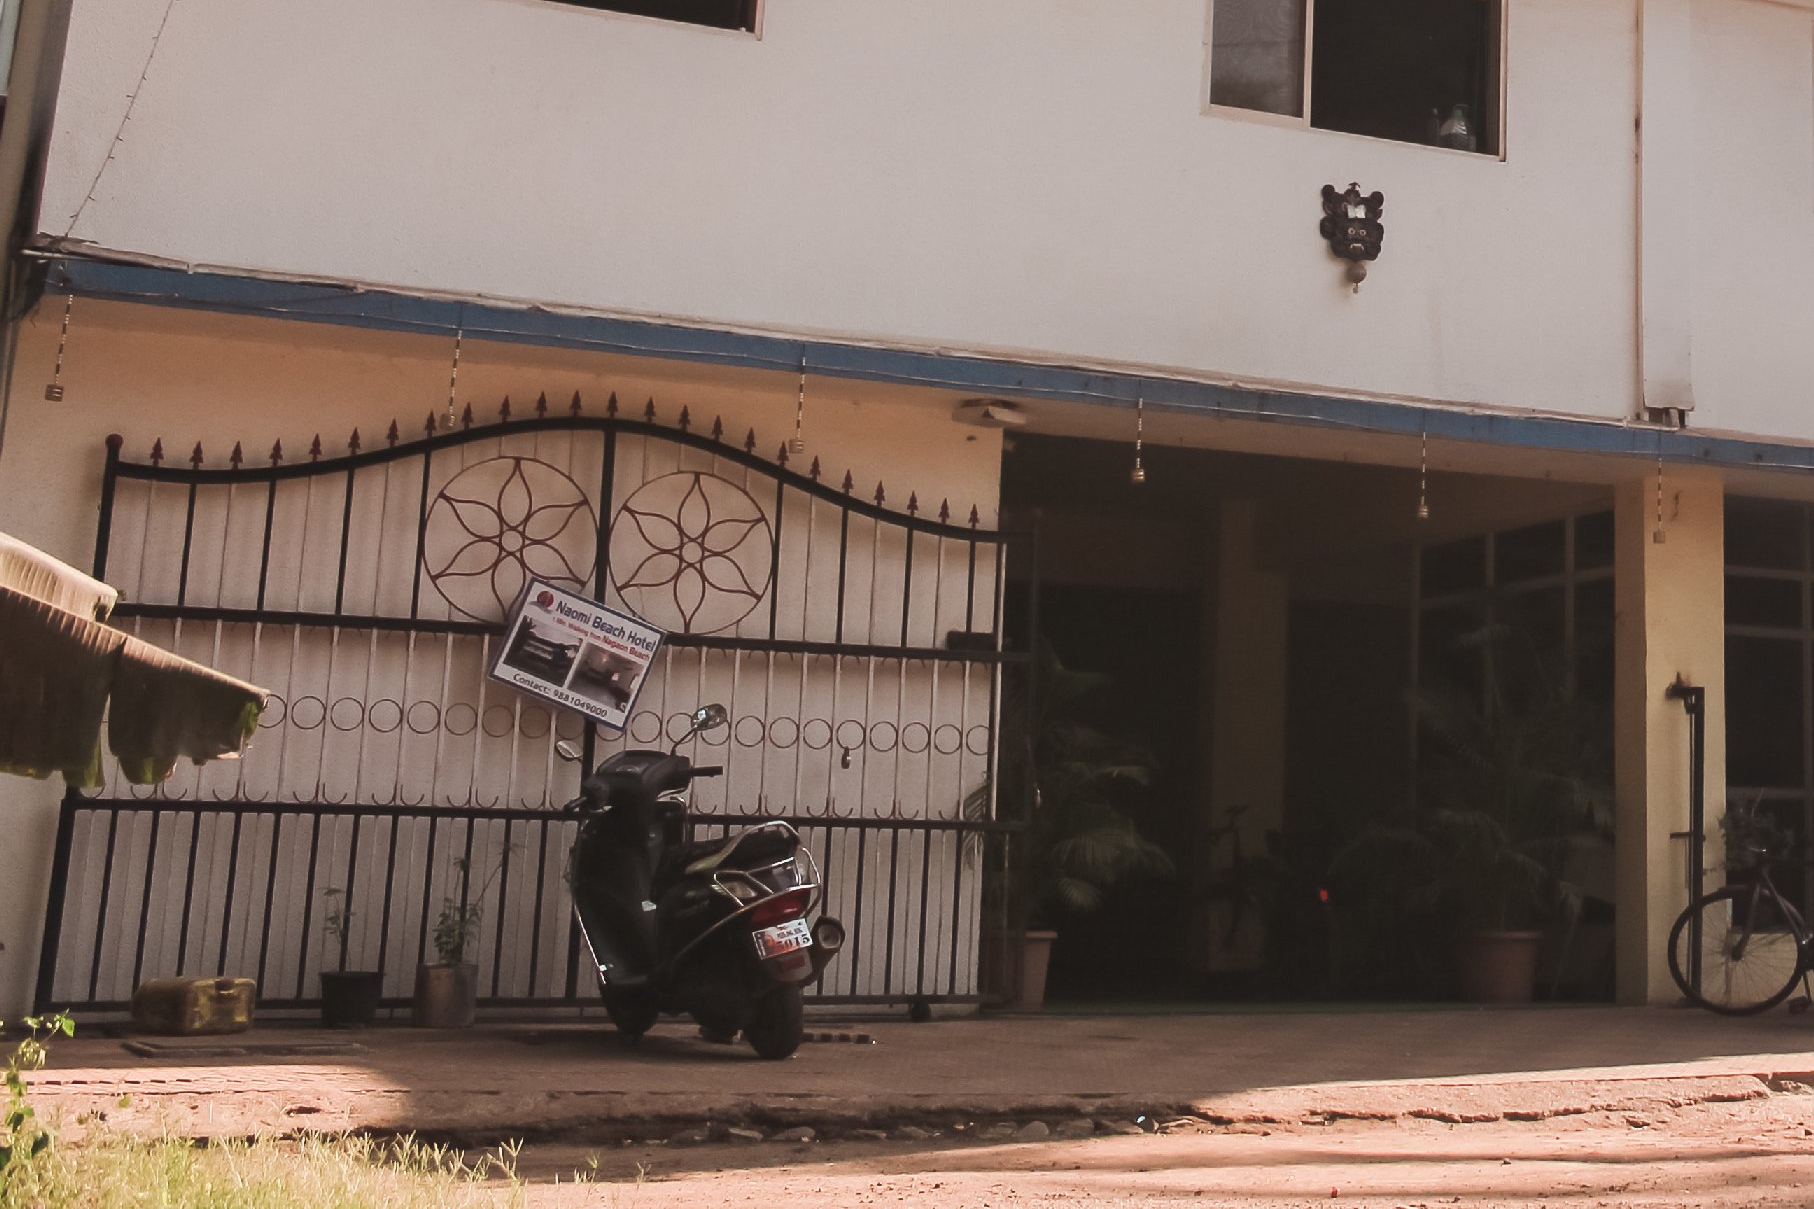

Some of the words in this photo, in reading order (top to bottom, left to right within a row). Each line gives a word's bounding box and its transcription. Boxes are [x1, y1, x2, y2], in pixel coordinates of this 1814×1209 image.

[556, 600, 592, 624] Naomi
[592, 616, 626, 639] Beach
[627, 631, 657, 653] Hotel
[629, 647, 651, 660] Beach
[513, 673, 551, 695] Contact:
